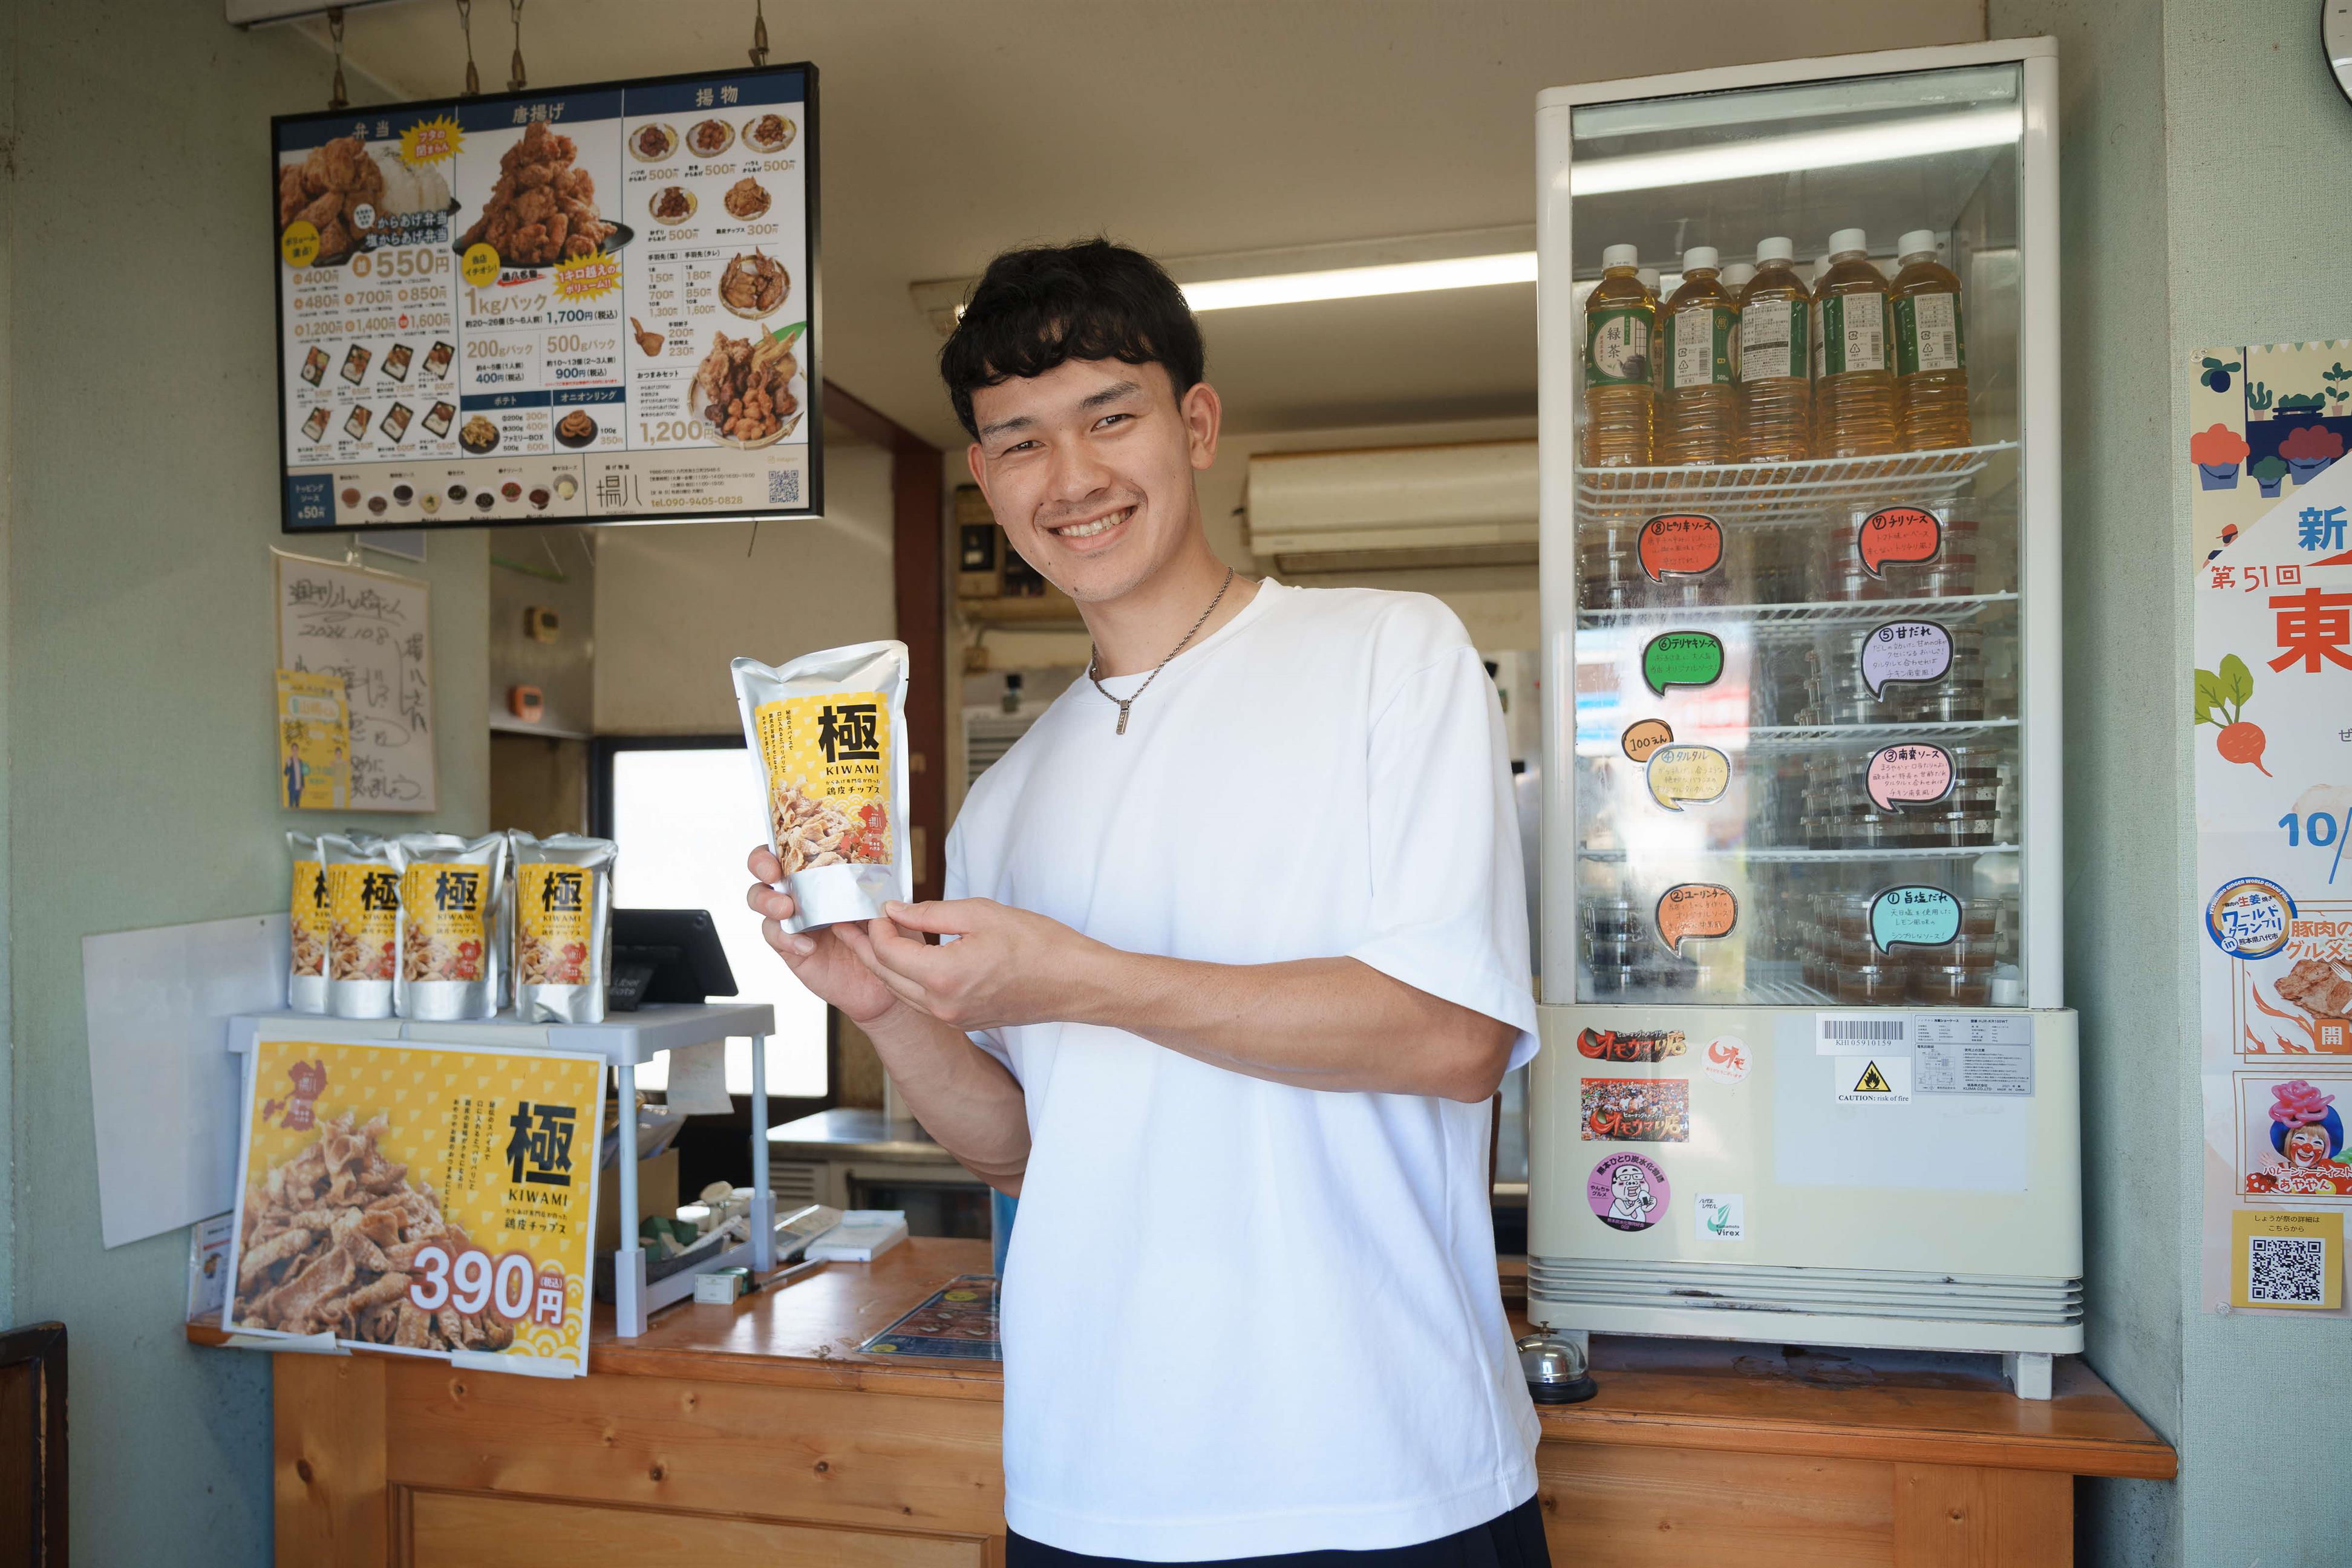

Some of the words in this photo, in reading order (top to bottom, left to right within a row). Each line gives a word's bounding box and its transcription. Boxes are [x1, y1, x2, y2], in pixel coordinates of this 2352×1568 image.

[696, 86, 738, 107] 揚物
[512, 102, 565, 123] 唐揚げ
[352, 120, 390, 139] 弁当
[377, 211, 448, 229] からあげ弁当
[1607, 327, 1621, 359] 緑茶
[560, 390, 616, 402] オニオンリング
[2298, 505, 2347, 552] 新
[2210, 564, 2301, 593] 第51回
[2267, 587, 2352, 673] 東
[818, 704, 880, 763] 極
[826, 765, 880, 776] KIWAMI
[826, 785, 880, 796] 鶏皮チップス
[434, 871, 480, 911] 極
[541, 871, 583, 912] 極
[2264, 881, 2281, 893] GRAND
[2280, 890, 2291, 904] PRIX
[543, 914, 581, 923] KIWAMI
[2221, 904, 2279, 927] ワールド
[2228, 917, 2282, 938] グランプリ
[2224, 939, 2236, 950] in
[2238, 932, 2279, 946] 熊本県八代市
[2321, 1025, 2343, 1046] 開
[506, 1101, 577, 1186] 極
[2279, 1178, 2332, 1192] あややん
[509, 1189, 568, 1207] KIWAMI
[505, 1217, 566, 1235] 鶏皮チップス
[2254, 1214, 2321, 1224] しょうが祭の詳細は
[2268, 1224, 2305, 1233] こちらから
[410, 1245, 564, 1325] 390円
